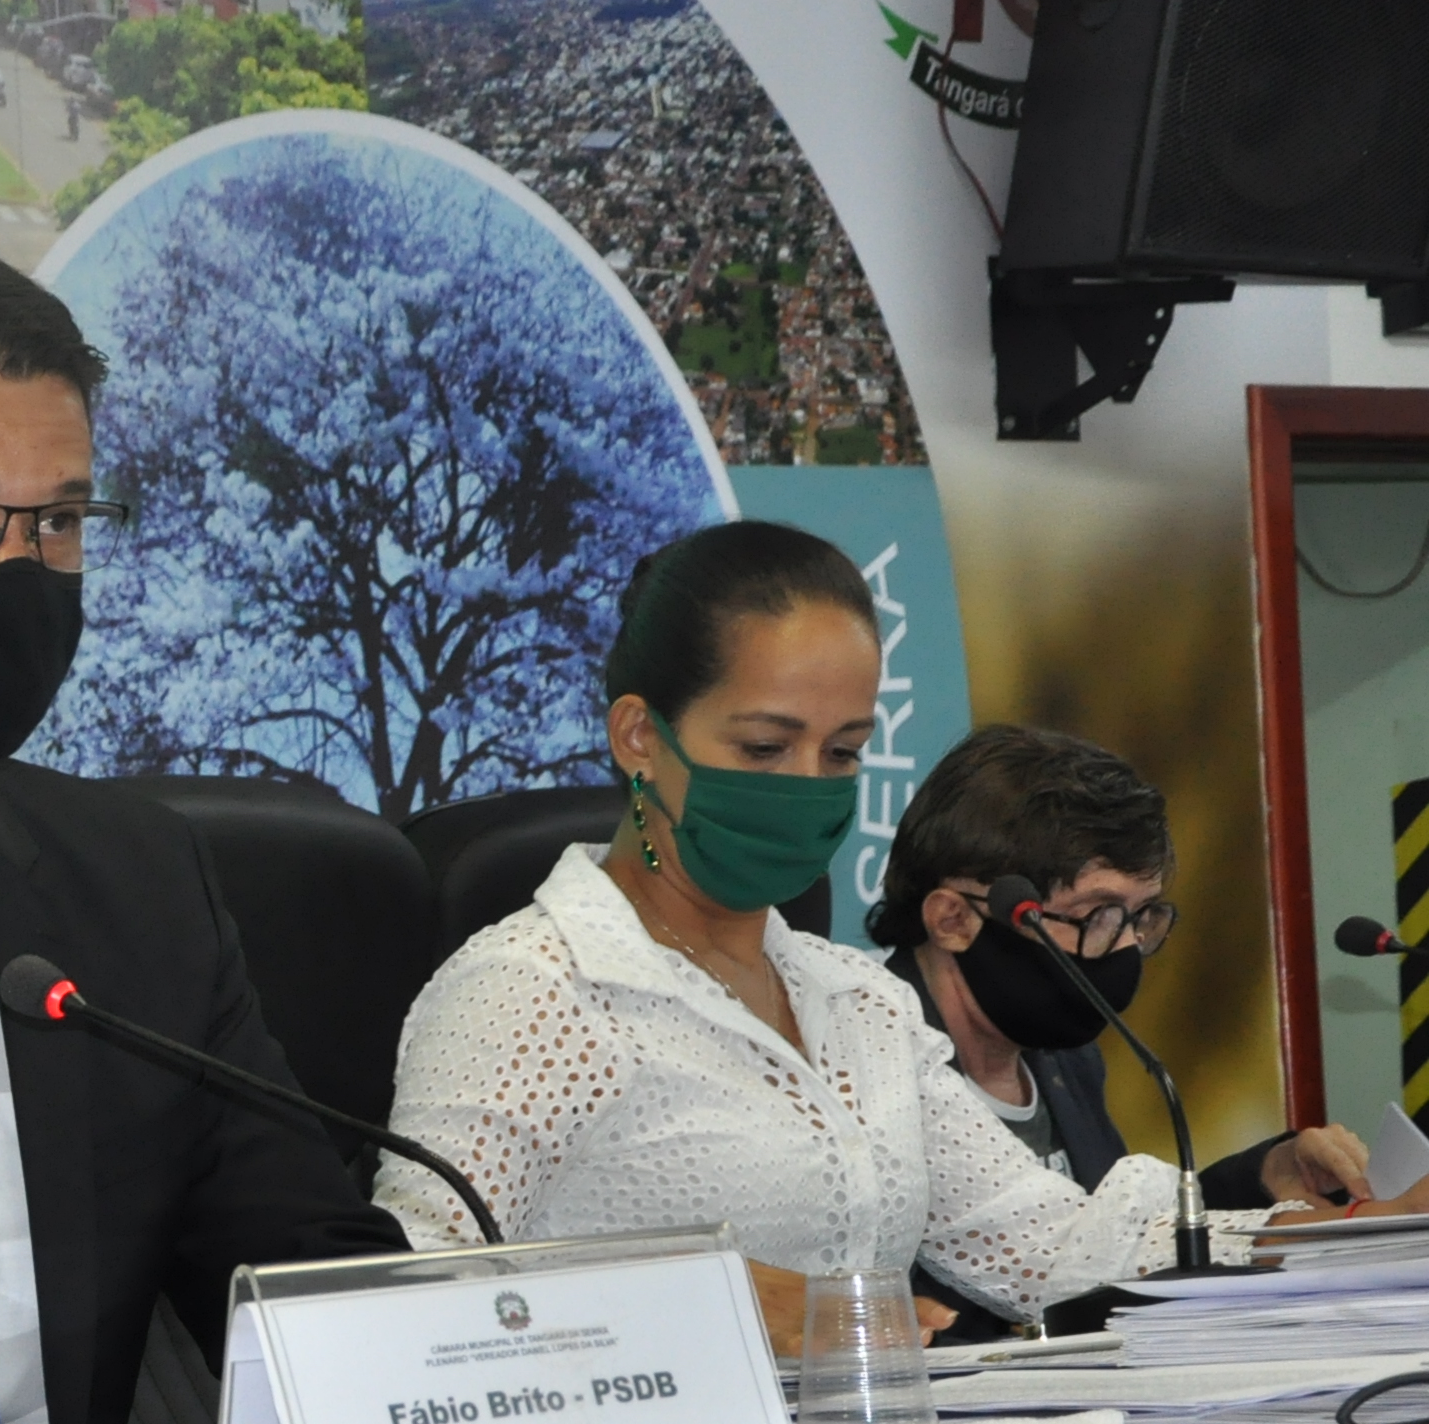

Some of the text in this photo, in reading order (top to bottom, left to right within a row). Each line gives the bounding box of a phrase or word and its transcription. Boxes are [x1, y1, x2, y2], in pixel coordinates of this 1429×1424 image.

[468, 1337, 512, 1350] MUNICIPAL
[514, 1336, 525, 1345] DE
[486, 1387, 566, 1420] Brito
[591, 1371, 678, 1405] PSDB
